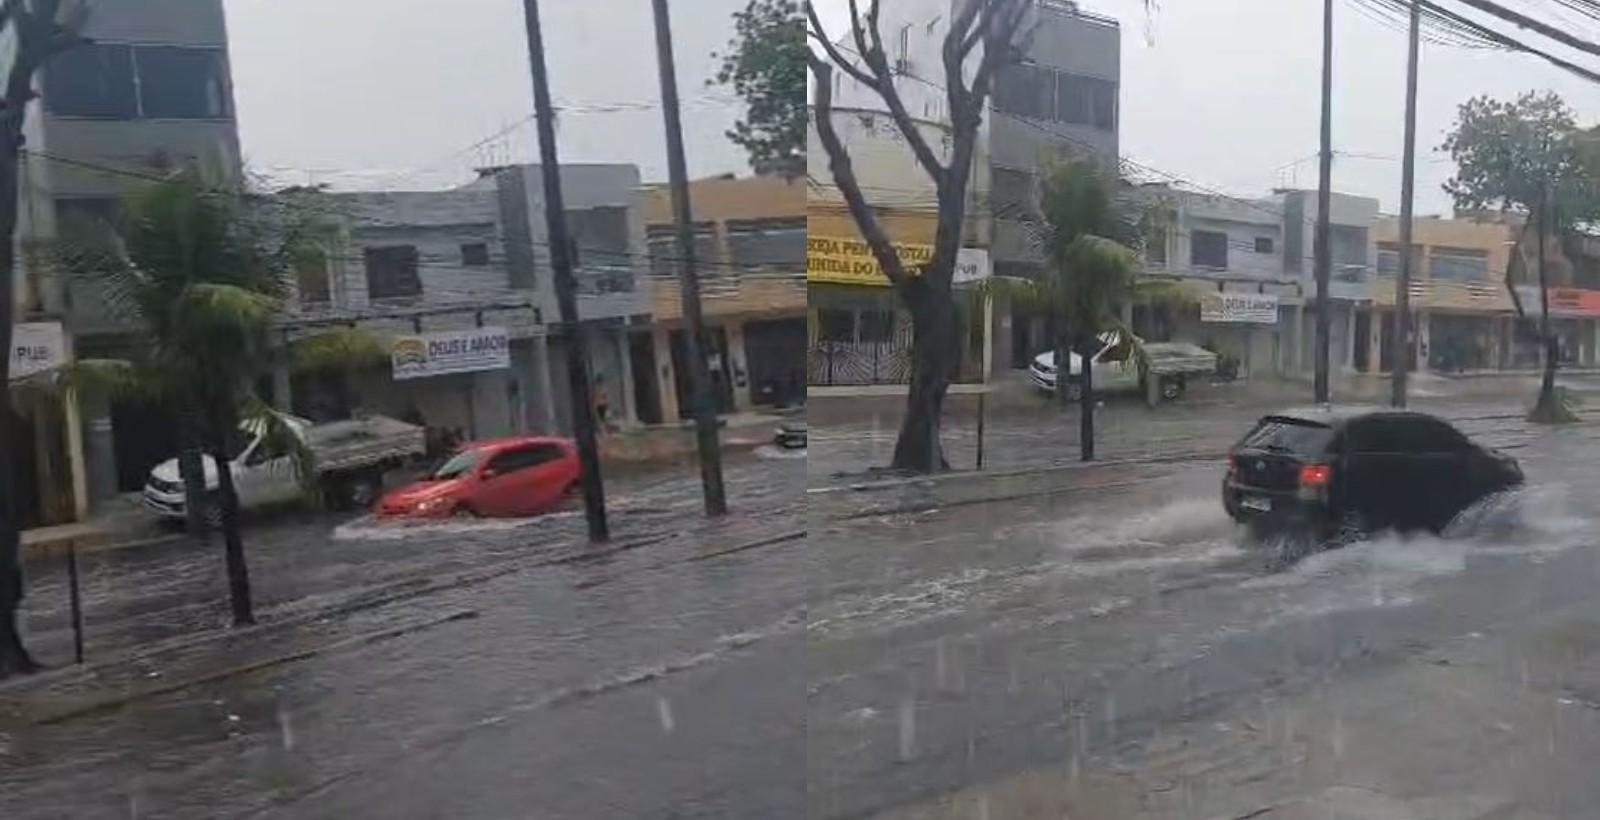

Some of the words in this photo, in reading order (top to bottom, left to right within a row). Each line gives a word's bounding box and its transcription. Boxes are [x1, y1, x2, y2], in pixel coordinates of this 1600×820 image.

[853, 261, 873, 275] DO
[428, 339, 460, 357] DEUS
[470, 335, 508, 352] AMOR
